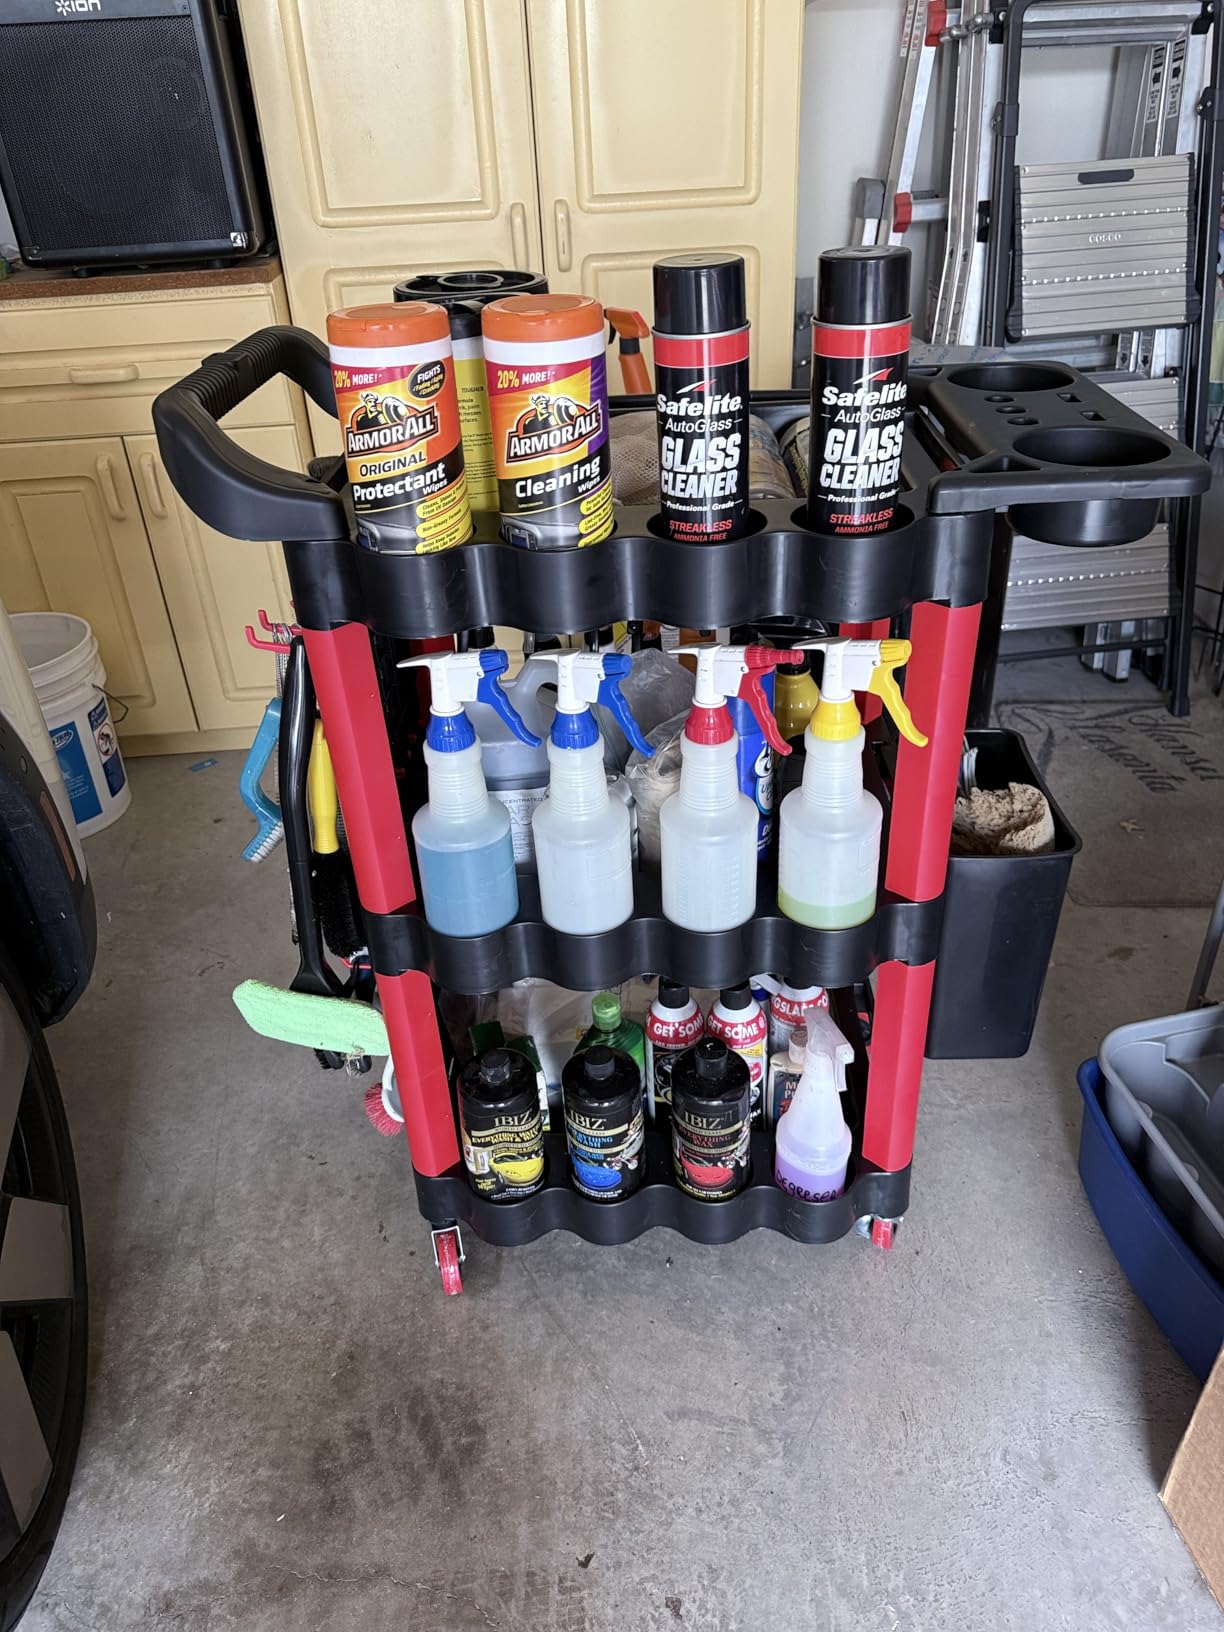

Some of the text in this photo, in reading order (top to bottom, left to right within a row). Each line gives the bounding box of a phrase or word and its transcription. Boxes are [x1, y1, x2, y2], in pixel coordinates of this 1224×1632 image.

[334, 370, 378, 388] 20% MORE!
[417, 364, 441, 383] FIGHTS
[497, 370, 551, 389] 20% MORE!
[821, 381, 907, 407] Safelite
[656, 392, 742, 417] Safelite
[665, 417, 733, 433] AutoGlass
[834, 407, 901, 424] AutoGlass
[823, 420, 905, 464] GLASS
[661, 432, 742, 473] GLASS
[359, 450, 427, 478] ORIGINAL
[819, 456, 901, 490] CLEANER
[352, 462, 446, 502] Protectant
[515, 455, 601, 498] Cleaning
[577, 476, 601, 494] Wipes
[661, 469, 739, 499] CLEANER
[422, 478, 448, 496] Wipes
[666, 500, 735, 513] Professional Grade
[827, 493, 878, 503] Professional
[829, 507, 894, 525] STREAKLESS
[669, 519, 733, 533] STREAKLESS
[834, 520, 890, 534] AMMONIA FREE
[673, 531, 728, 543] AMMONIA FREE
[653, 1022, 675, 1038] GET
[707, 1015, 759, 1039] GET SOME
[494, 1108, 533, 1127] IBIZ
[569, 1110, 606, 1130] IBIZ
[684, 1111, 722, 1130] IBIZ
